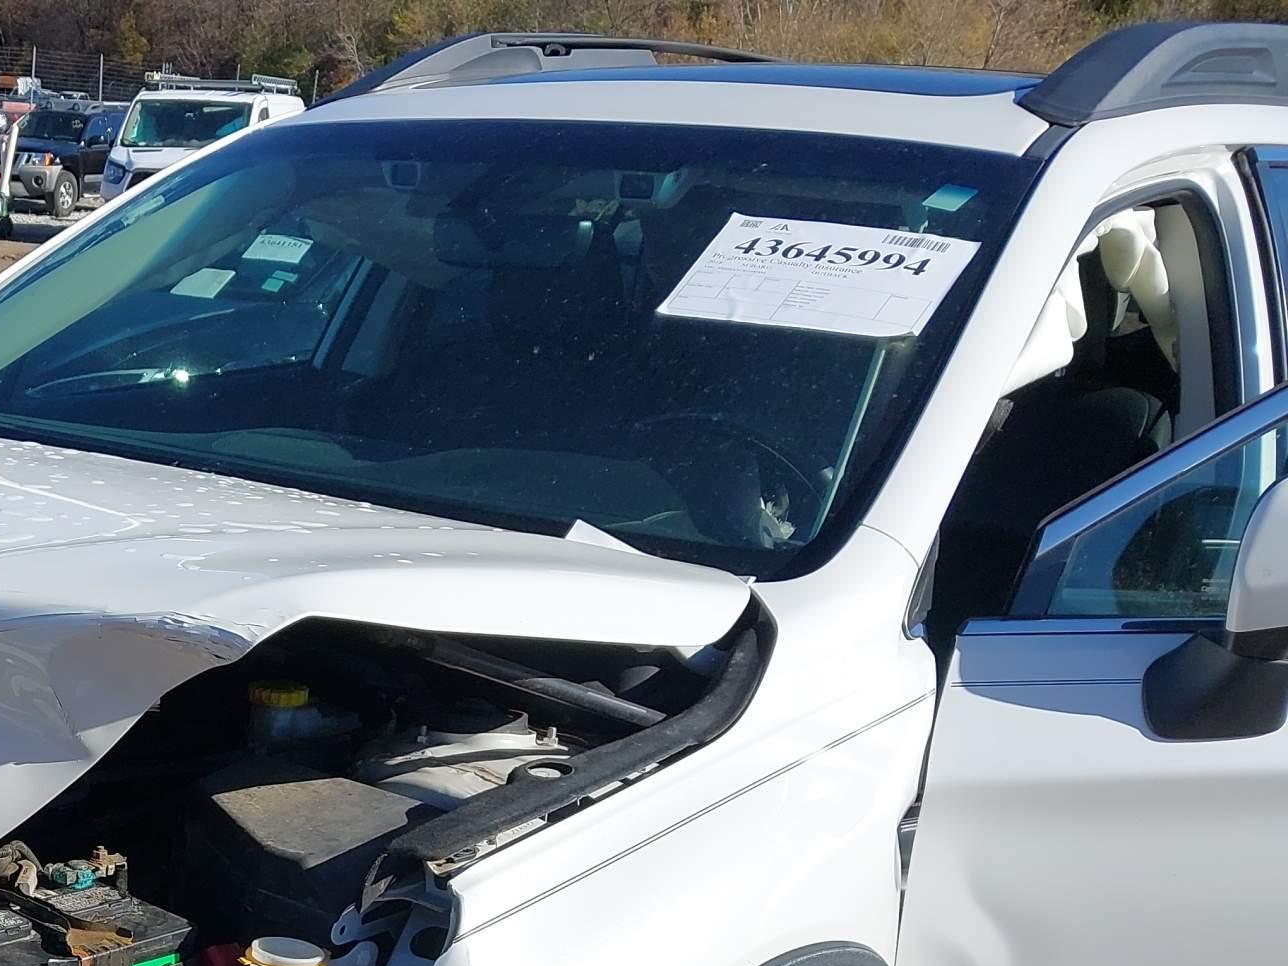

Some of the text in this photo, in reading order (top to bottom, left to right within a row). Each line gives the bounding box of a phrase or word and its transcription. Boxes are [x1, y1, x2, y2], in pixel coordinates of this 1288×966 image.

[734, 236, 932, 276] 43645994
[769, 257, 813, 269] Casualty
[814, 263, 863, 275] Insurance
